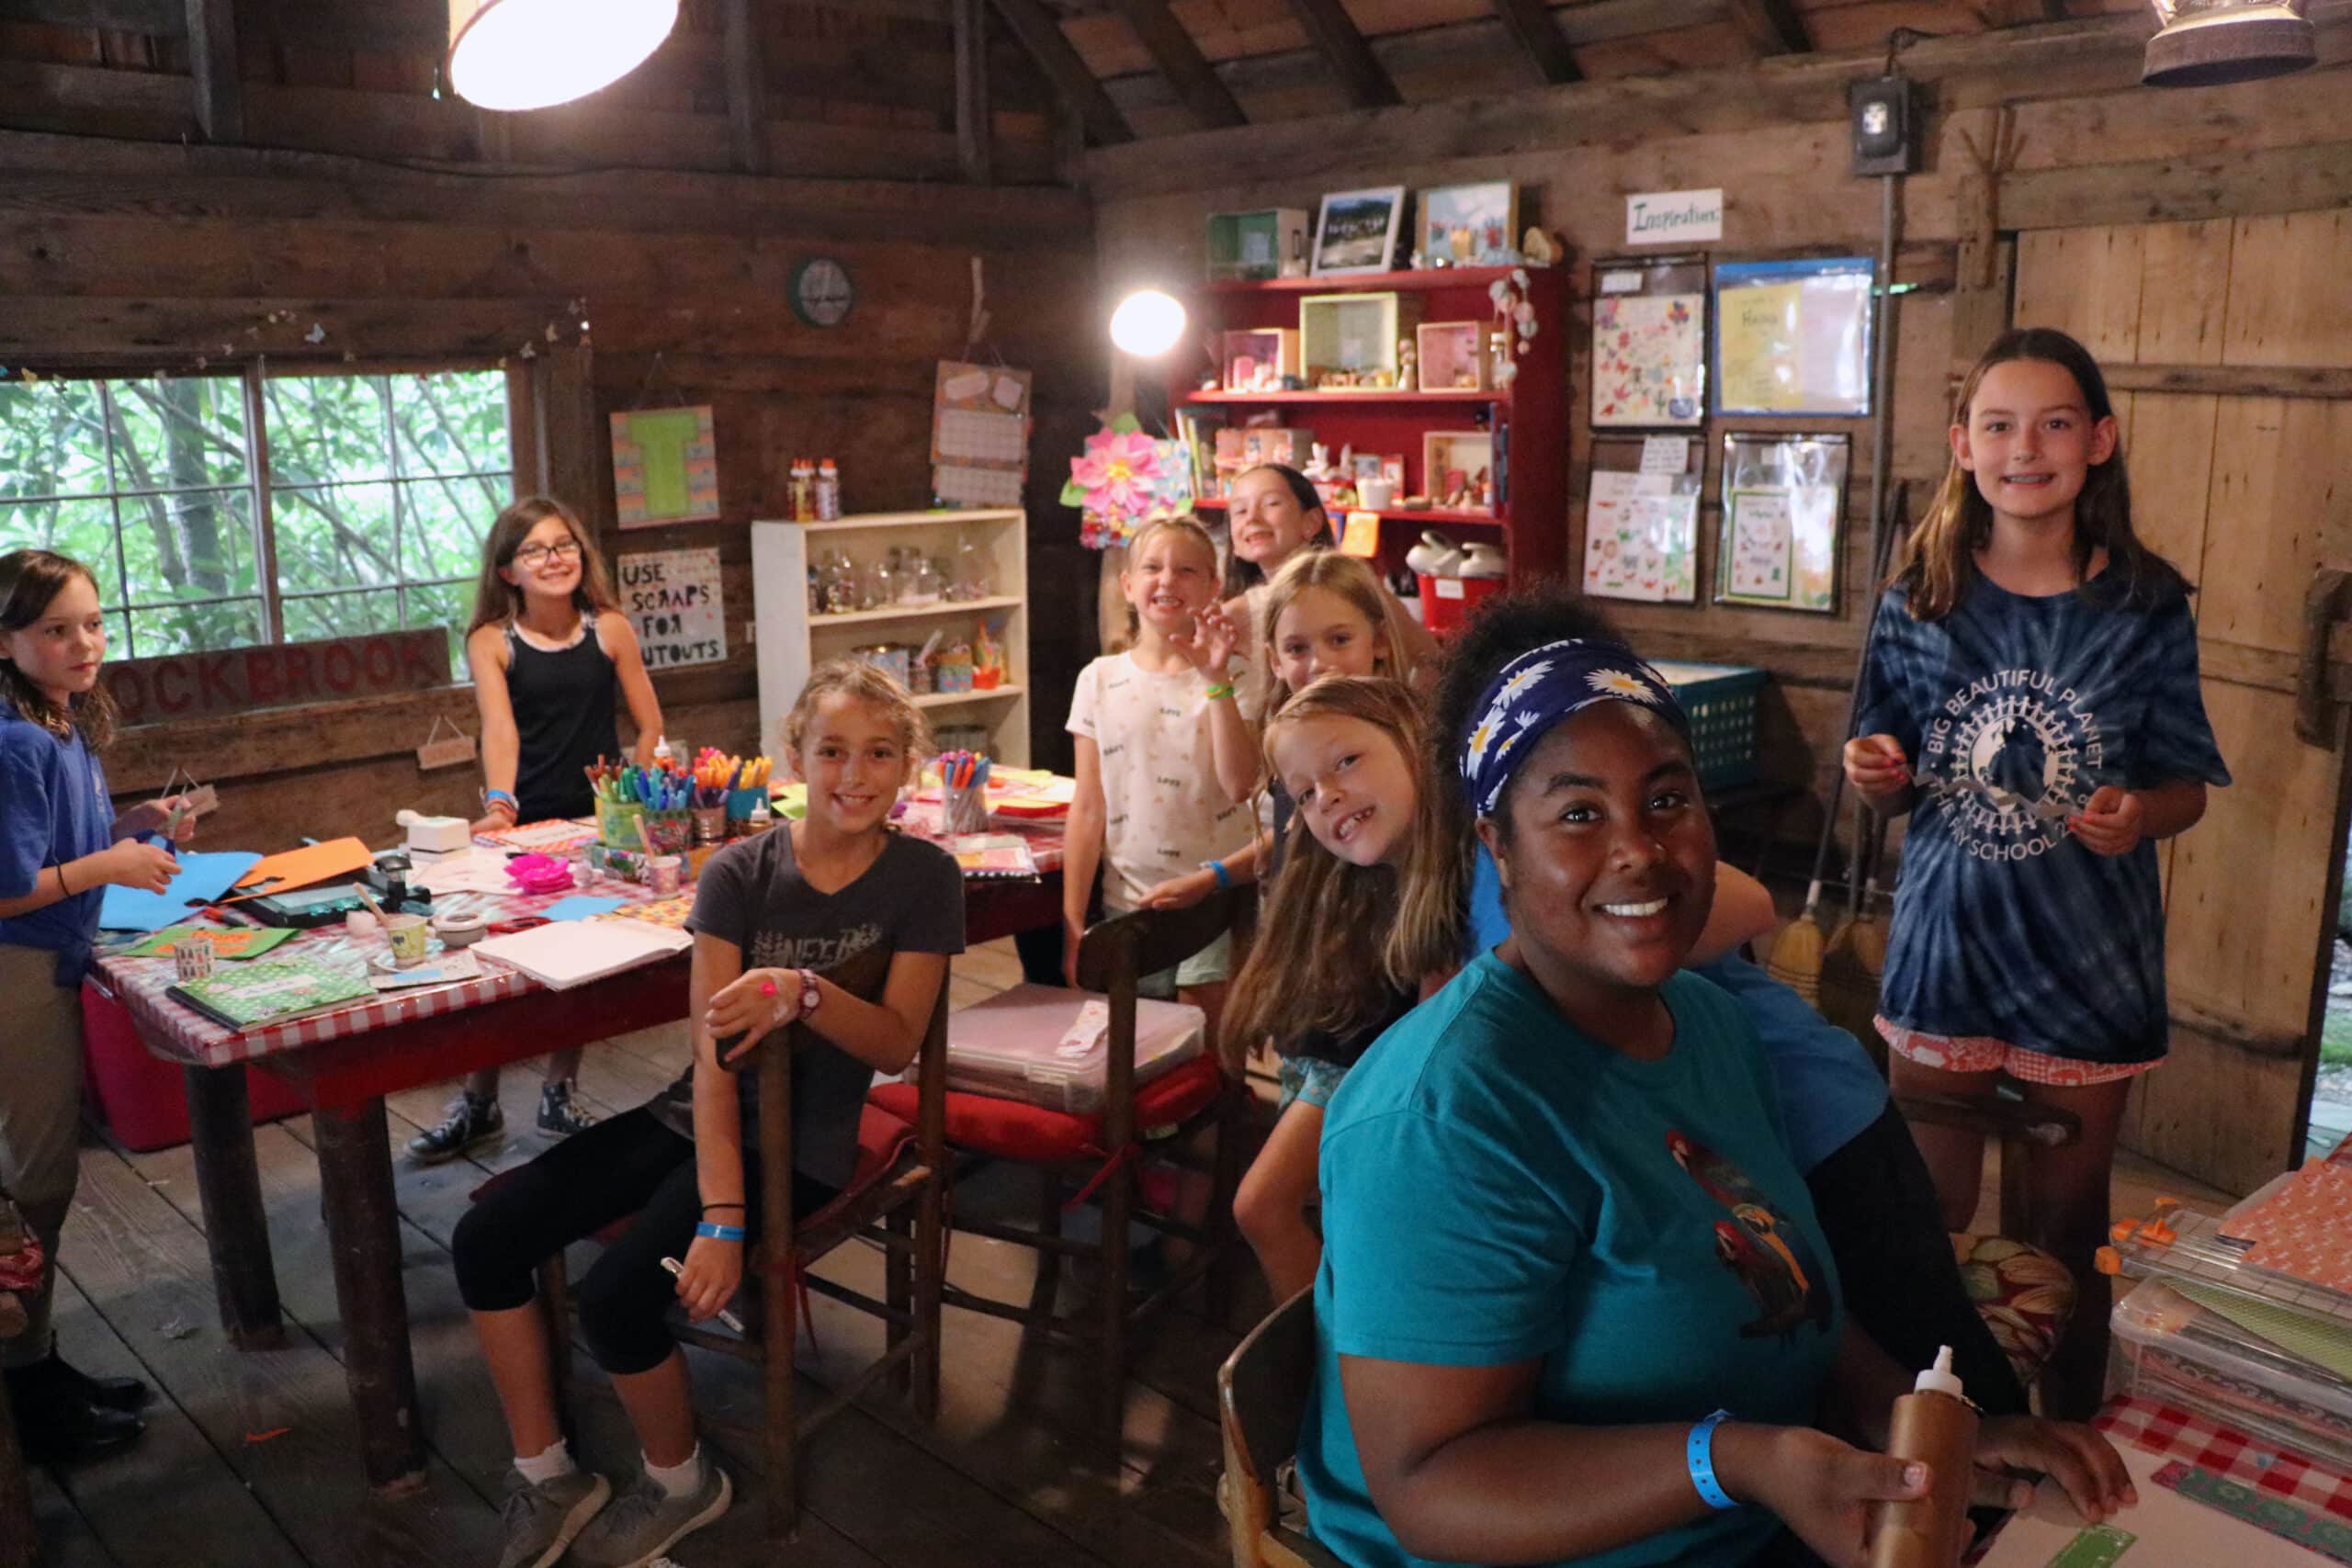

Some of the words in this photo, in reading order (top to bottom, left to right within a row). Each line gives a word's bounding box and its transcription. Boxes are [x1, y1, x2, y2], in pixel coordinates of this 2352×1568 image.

[622, 563, 666, 586] USE
[631, 584, 710, 613] SCRAPS
[641, 613, 683, 638] FOR
[641, 638, 719, 667] UTOUTS
[107, 633, 442, 720] OCKBROOK
[1928, 717, 1951, 754] BIG
[1944, 669, 2056, 716] BEAUTIFUL
[2058, 687, 2103, 770] PLANET
[1969, 835, 2057, 862] SCHOOL
